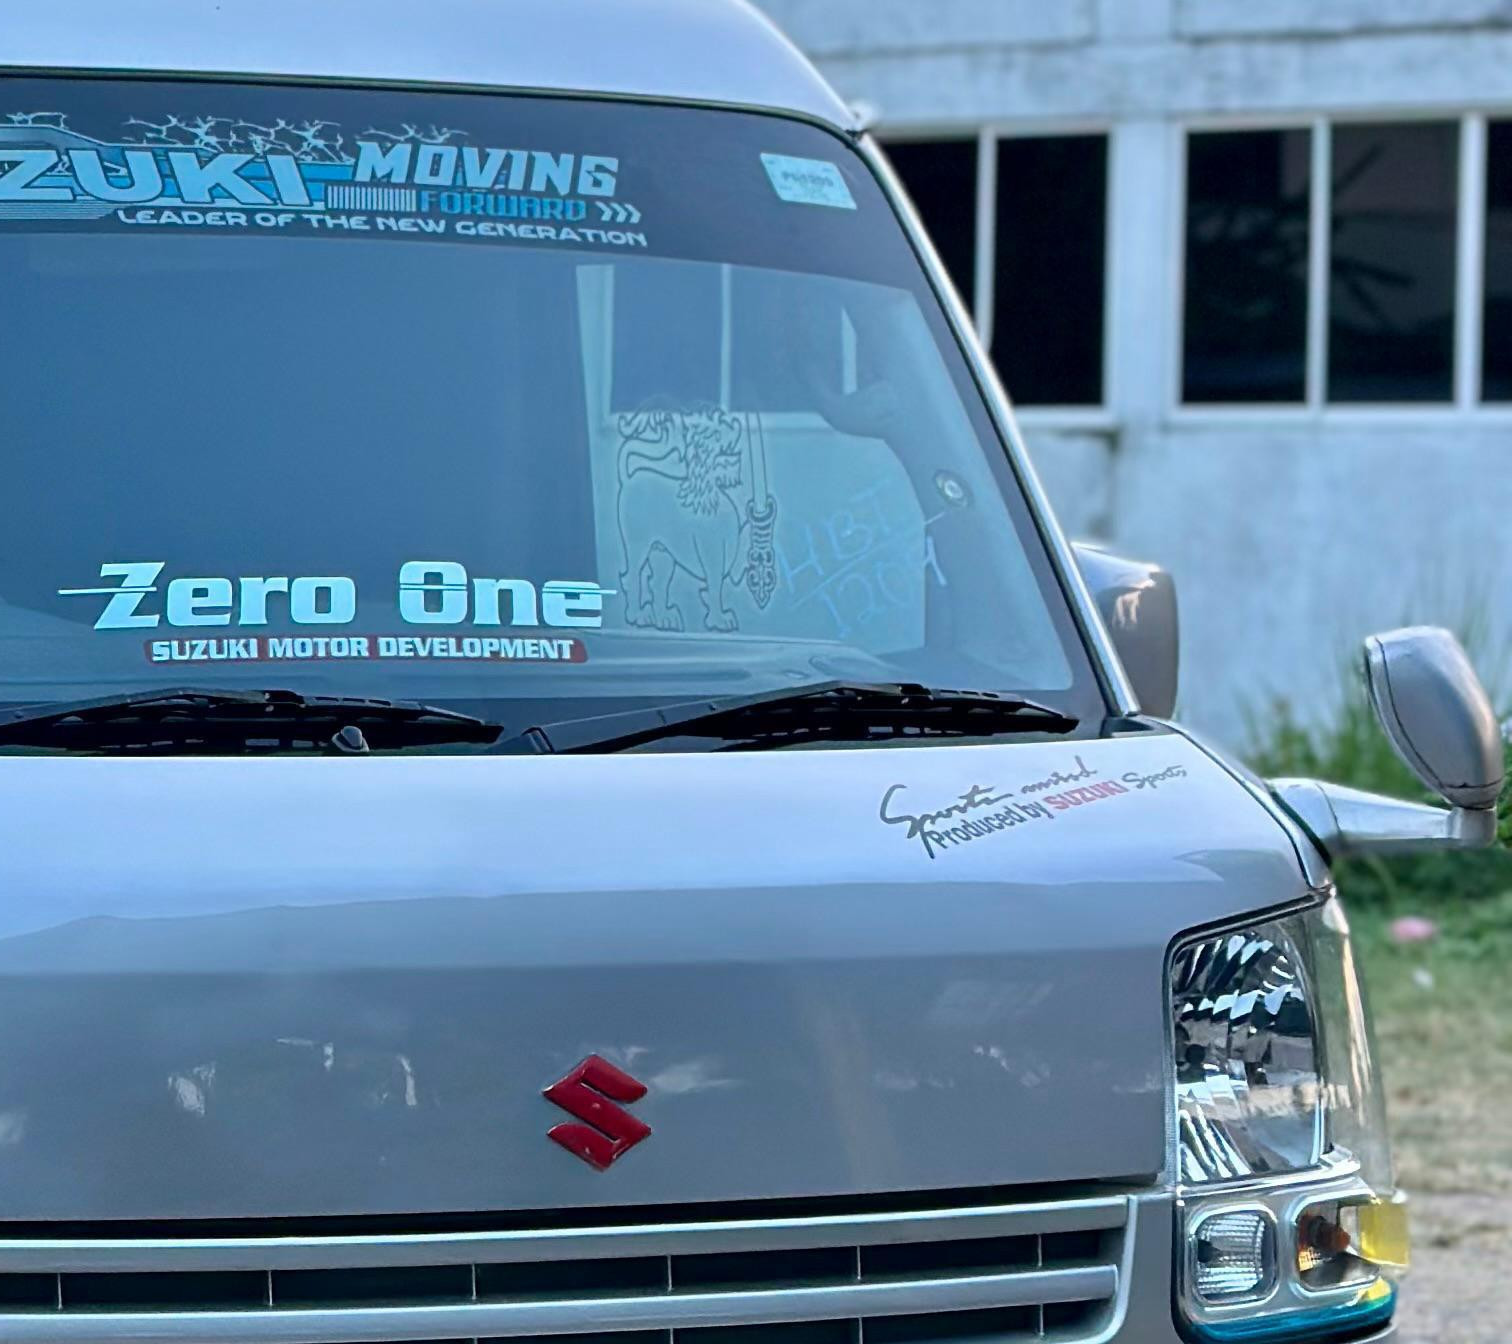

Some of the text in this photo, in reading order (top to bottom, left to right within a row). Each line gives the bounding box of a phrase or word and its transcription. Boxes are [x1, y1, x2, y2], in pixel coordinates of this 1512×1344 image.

[354, 141, 619, 197] MOVING
[117, 209, 648, 247] LEADER OF THE NEW GENERATION
[421, 190, 586, 221] FORWARD
[93, 560, 603, 629] Zero One
[151, 636, 574, 662] SUZUKI MOTOR DEVELOPMENT
[925, 805, 1027, 849] Produced
[1012, 801, 1054, 820] by
[1042, 780, 1130, 810] SUZUKI
